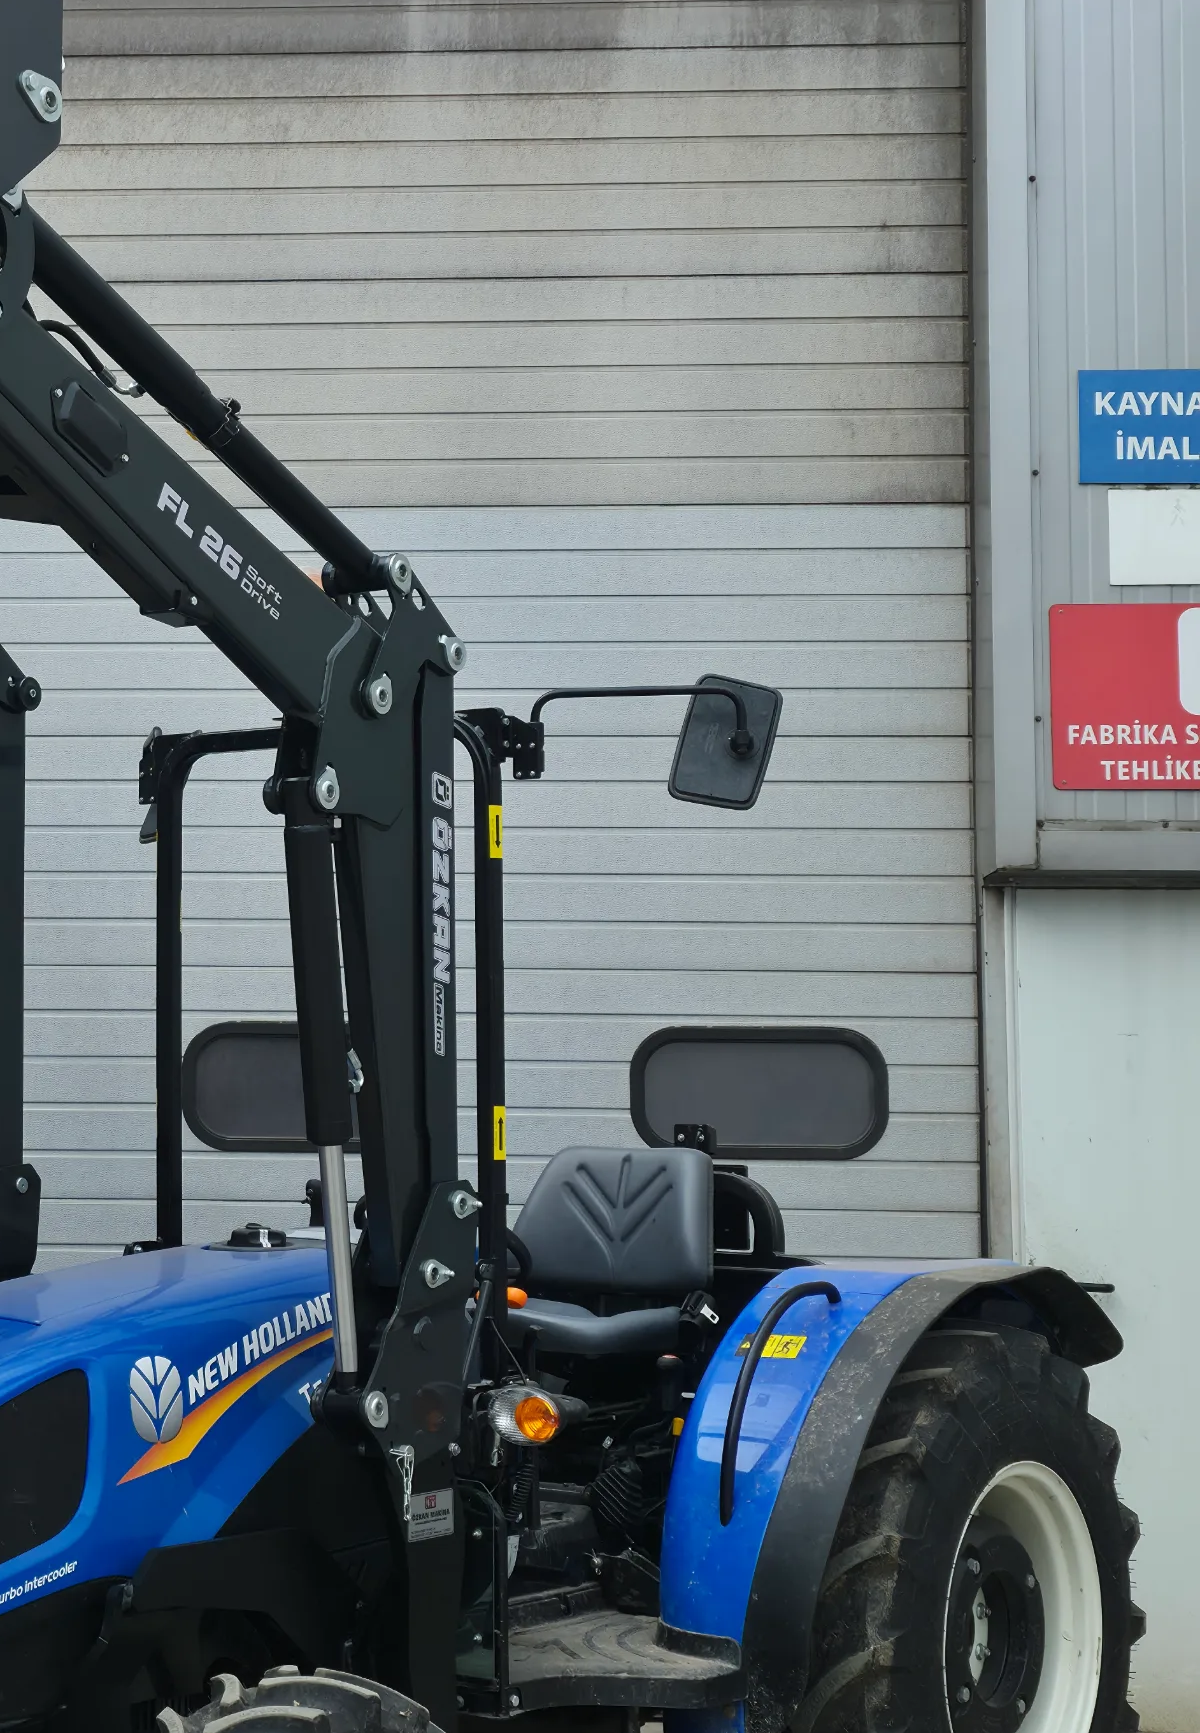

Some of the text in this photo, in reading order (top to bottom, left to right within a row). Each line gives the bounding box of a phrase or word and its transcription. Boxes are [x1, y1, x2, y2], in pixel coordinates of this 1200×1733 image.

[1095, 391, 1200, 416] KAYNA
[1116, 429, 1200, 460] İMAL
[156, 481, 244, 581] FL 26
[240, 577, 280, 620] Drive
[245, 564, 283, 605] Soft
[1068, 719, 1178, 745] FABRİKA
[432, 816, 453, 984] ÖZKAN
[435, 986, 445, 1053] Makina
[188, 1341, 238, 1405] NEW
[24, 1560, 78, 1594] intercooler
